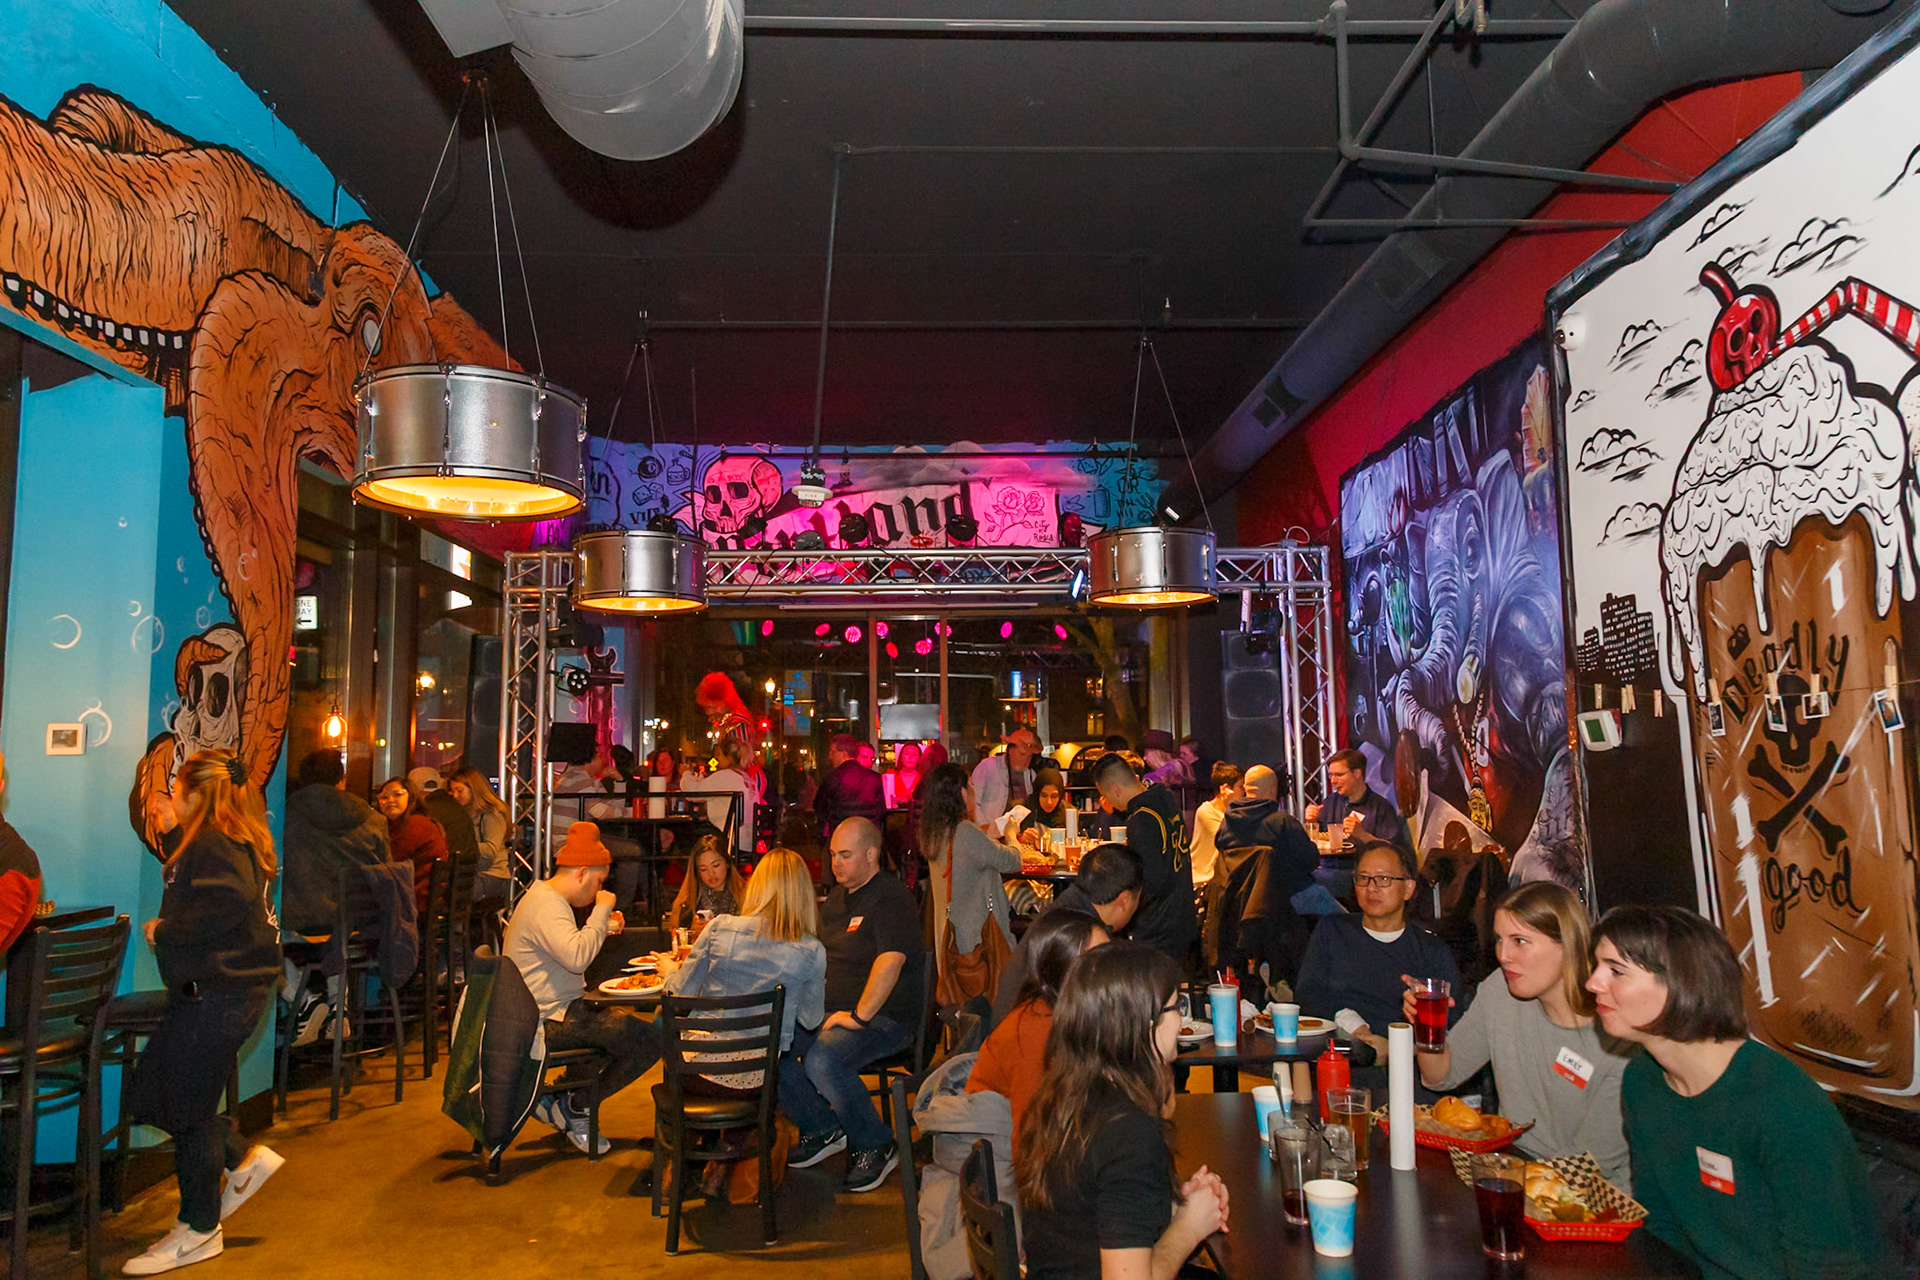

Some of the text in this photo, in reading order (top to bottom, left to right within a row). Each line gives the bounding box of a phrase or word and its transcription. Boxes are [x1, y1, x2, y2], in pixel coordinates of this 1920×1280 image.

[1722, 618, 1850, 725] Deadly
[1764, 846, 1868, 931] good
[1562, 1054, 1583, 1071] EMILY
